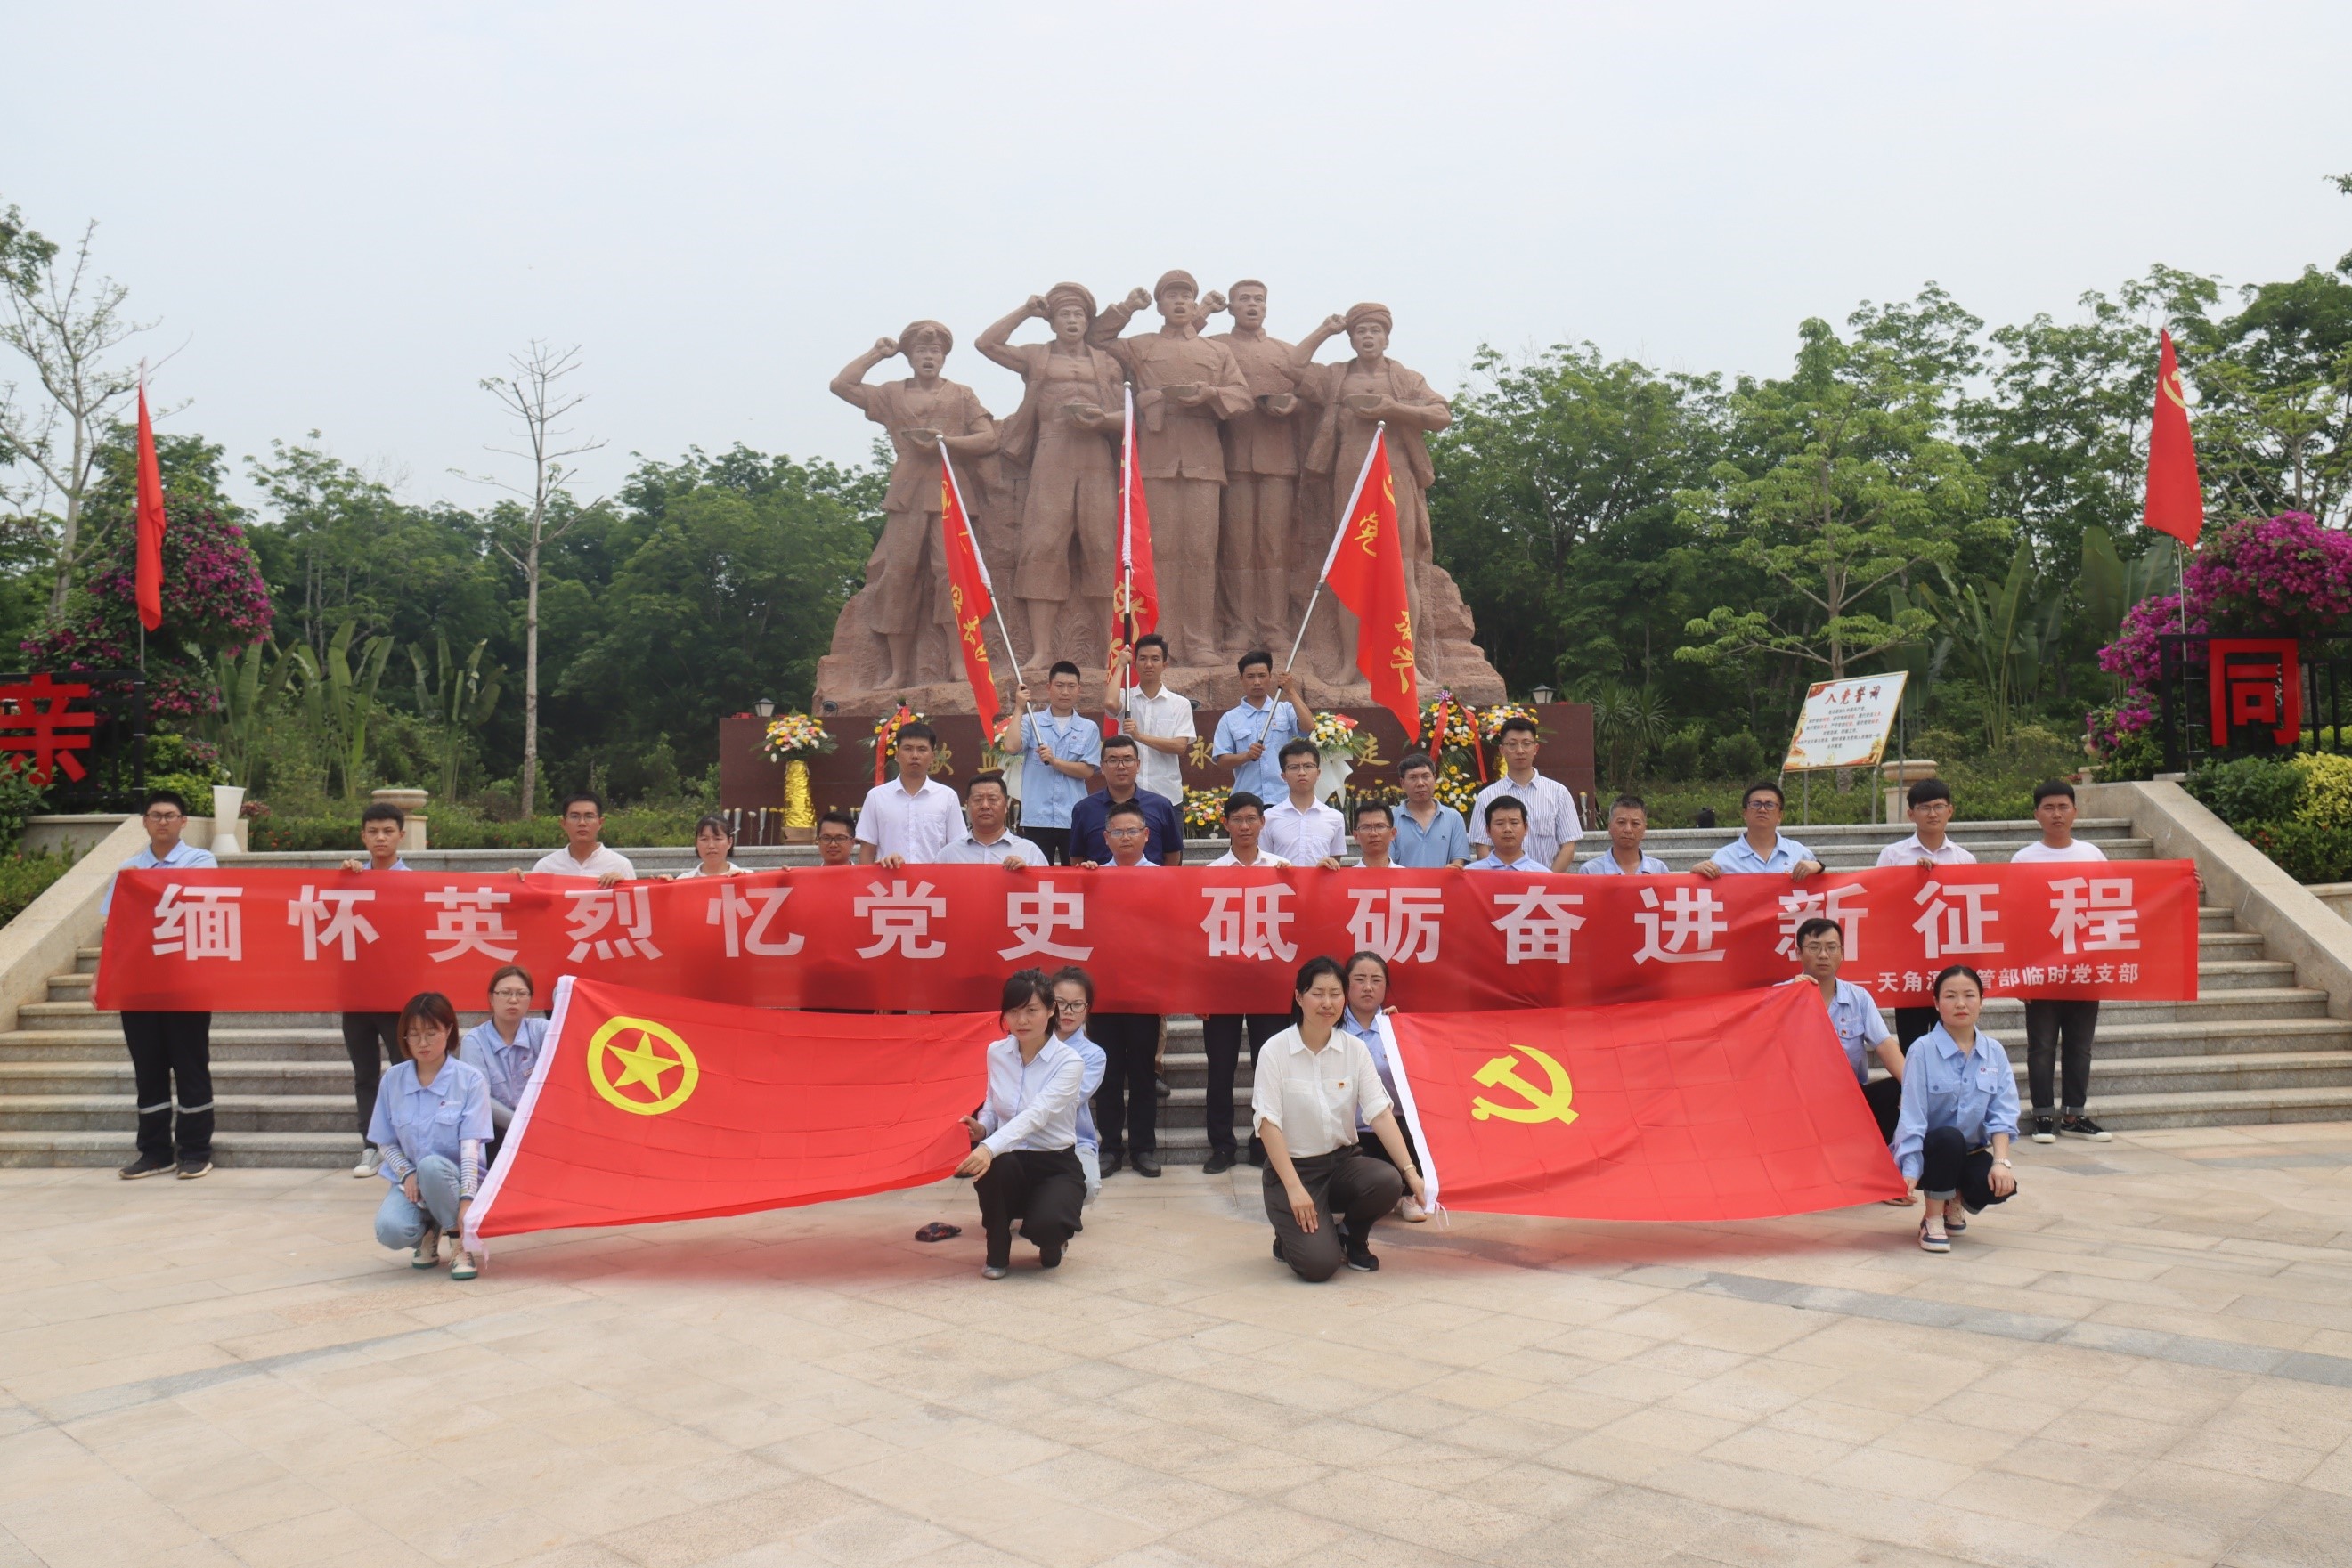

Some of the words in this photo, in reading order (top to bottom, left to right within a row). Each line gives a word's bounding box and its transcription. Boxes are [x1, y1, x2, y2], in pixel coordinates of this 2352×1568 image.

[2209, 639, 2300, 746] 同
[151, 881, 1095, 963] 缅怀英烈忆党史
[1200, 877, 2141, 966] 砥砺奋进新征程
